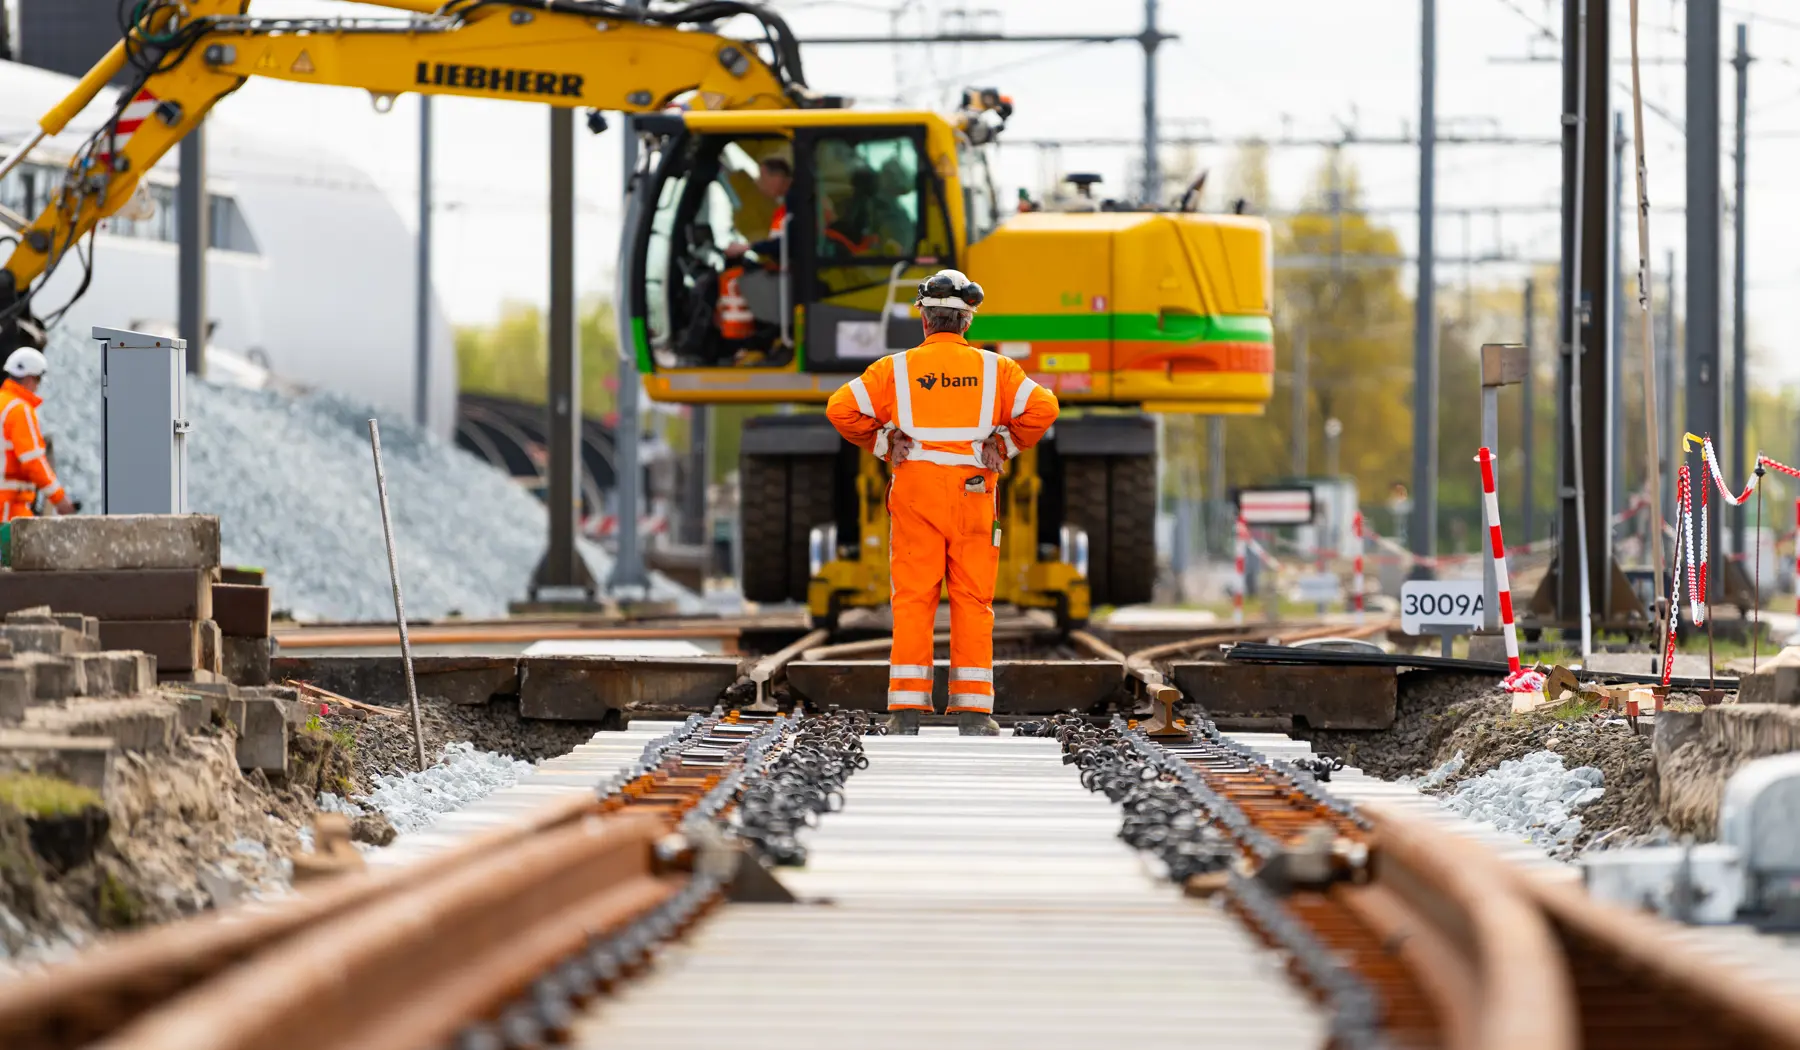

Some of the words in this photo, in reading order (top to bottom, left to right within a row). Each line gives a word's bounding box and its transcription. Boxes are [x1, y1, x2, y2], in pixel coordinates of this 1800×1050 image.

[416, 61, 584, 97] LIEBHERR
[941, 372, 978, 388] bam
[1404, 593, 1484, 616] 3009A
